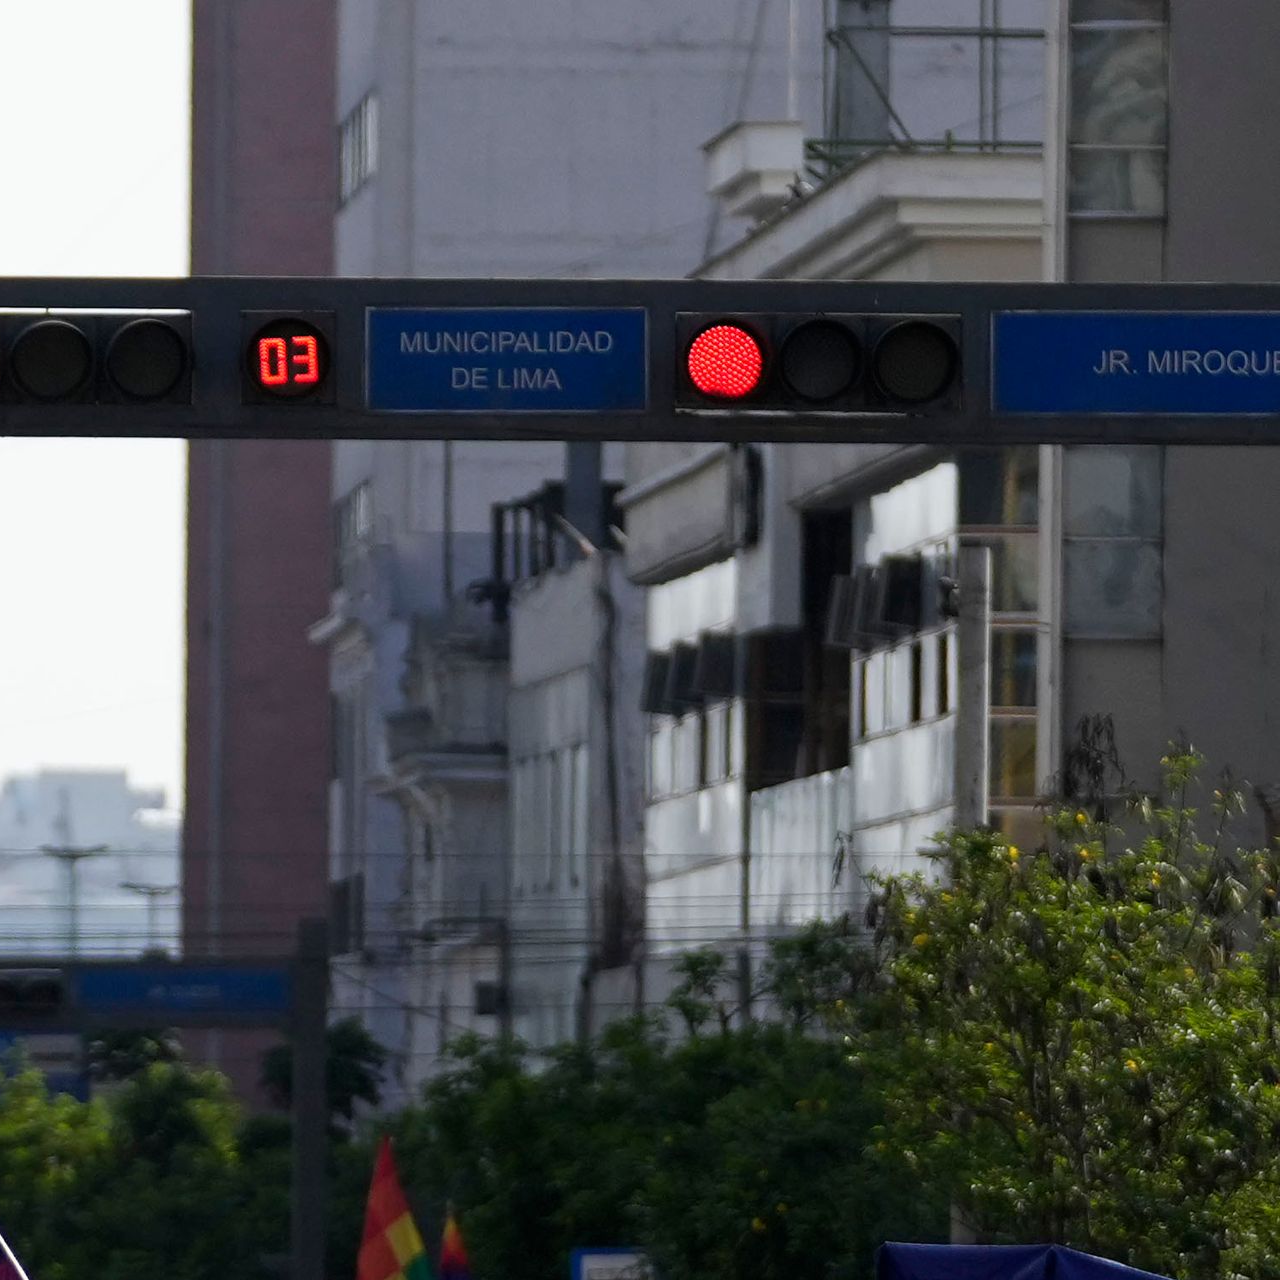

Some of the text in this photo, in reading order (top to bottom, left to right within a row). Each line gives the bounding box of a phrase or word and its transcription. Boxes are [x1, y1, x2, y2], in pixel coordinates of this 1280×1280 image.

[400, 331, 614, 355] MUNICIPALIDAD
[258, 336, 318, 386] 03
[1093, 350, 1137, 374] JR.
[451, 368, 560, 390] DE LIMA
